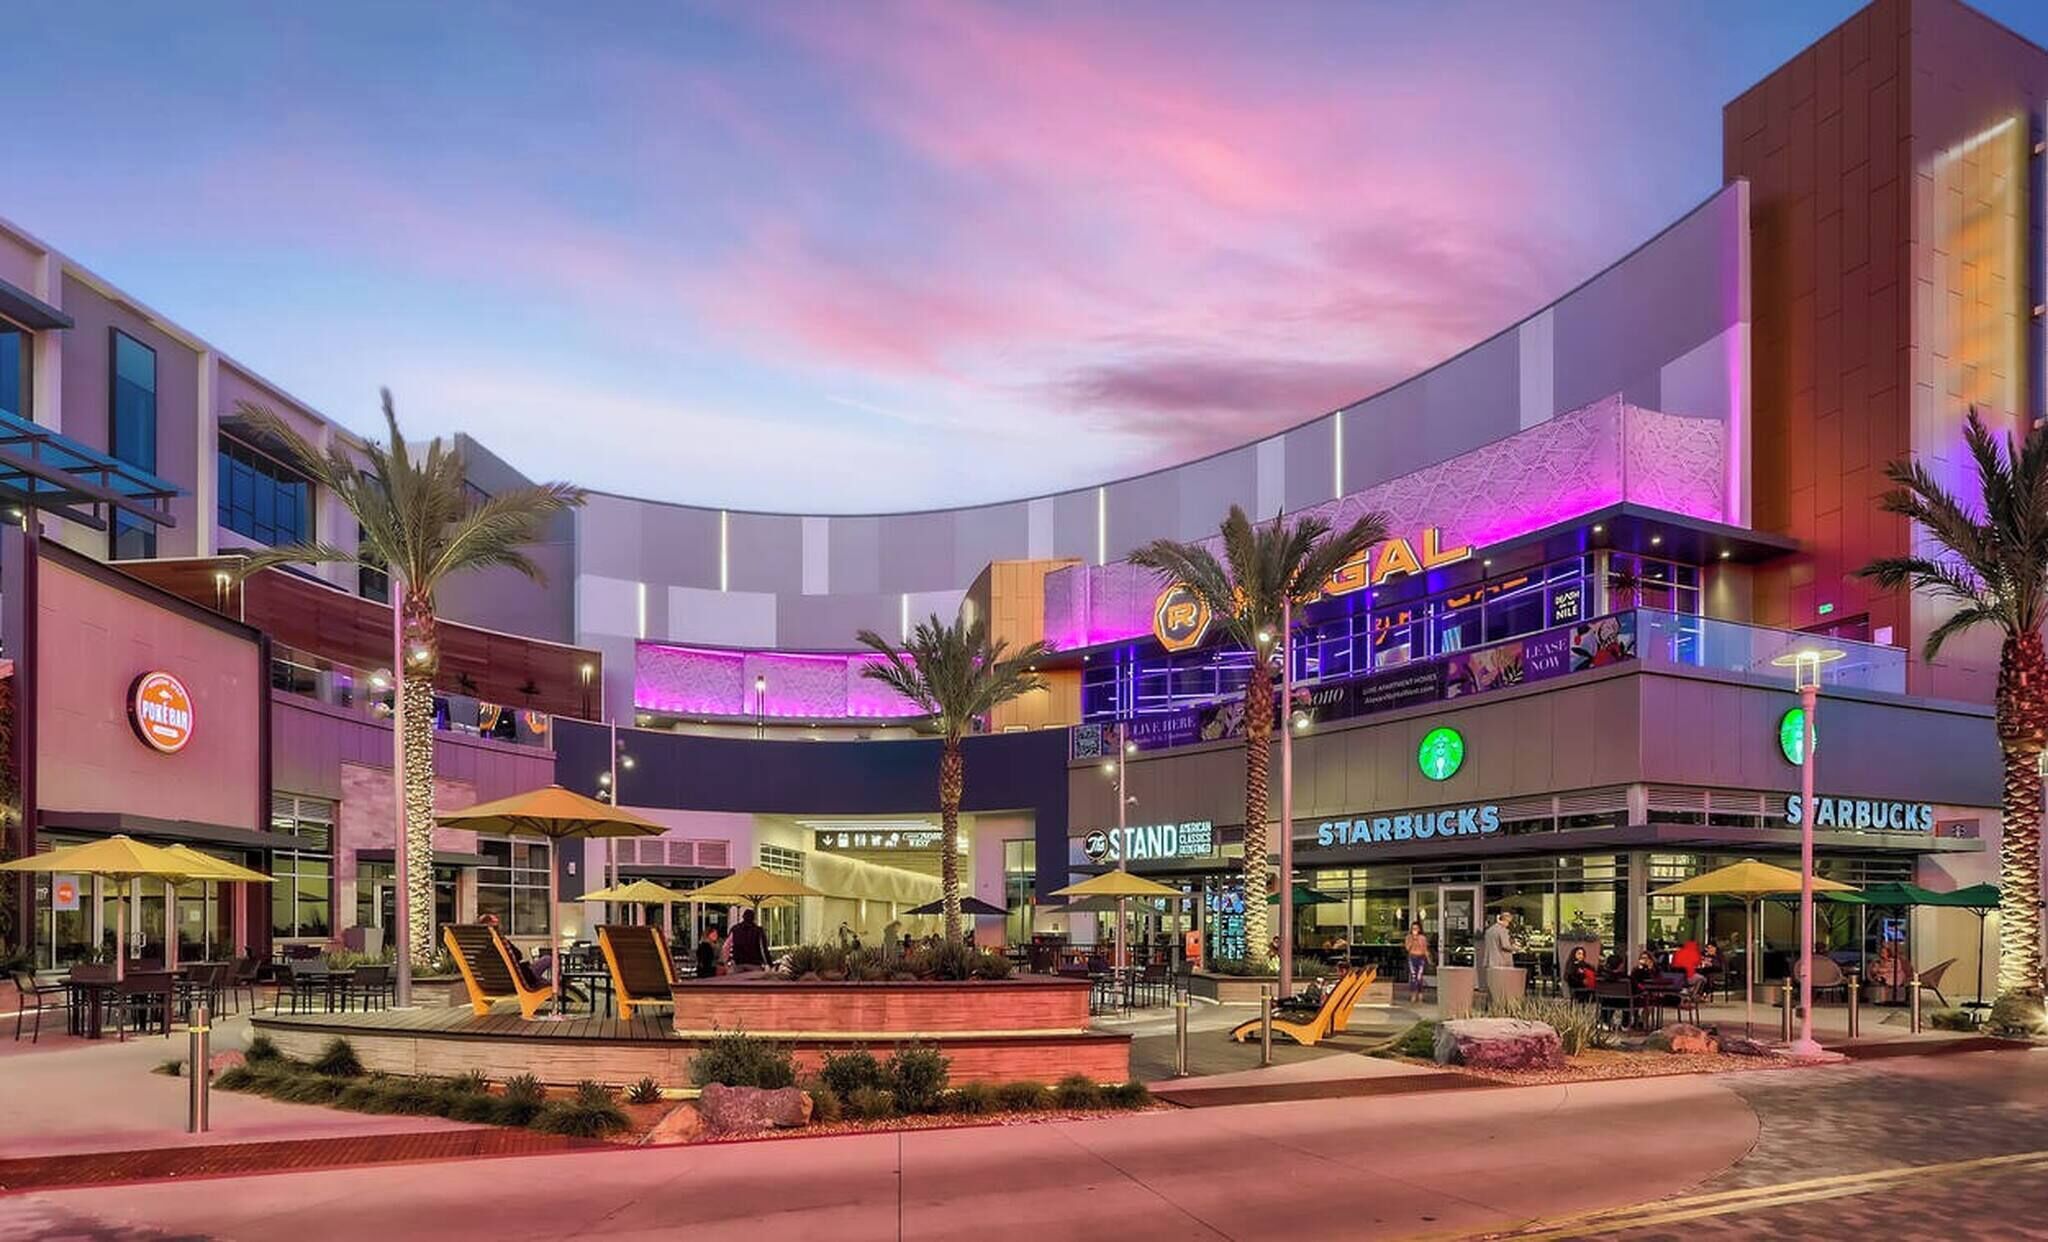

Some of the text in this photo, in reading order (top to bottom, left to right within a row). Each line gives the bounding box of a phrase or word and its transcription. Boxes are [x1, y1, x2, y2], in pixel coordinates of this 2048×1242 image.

[1555, 605, 1578, 620] NILE
[1526, 640, 1567, 659] LEASE
[1531, 656, 1559, 670] NOW
[1134, 717, 1196, 735] LIVE HERE
[1180, 821, 1212, 833] AMERICAN
[1317, 805, 1500, 846] STARBUCKS
[1086, 836, 1105, 854] The
[1109, 825, 1177, 859] STAND
[1179, 832, 1212, 844] CLASSICS
